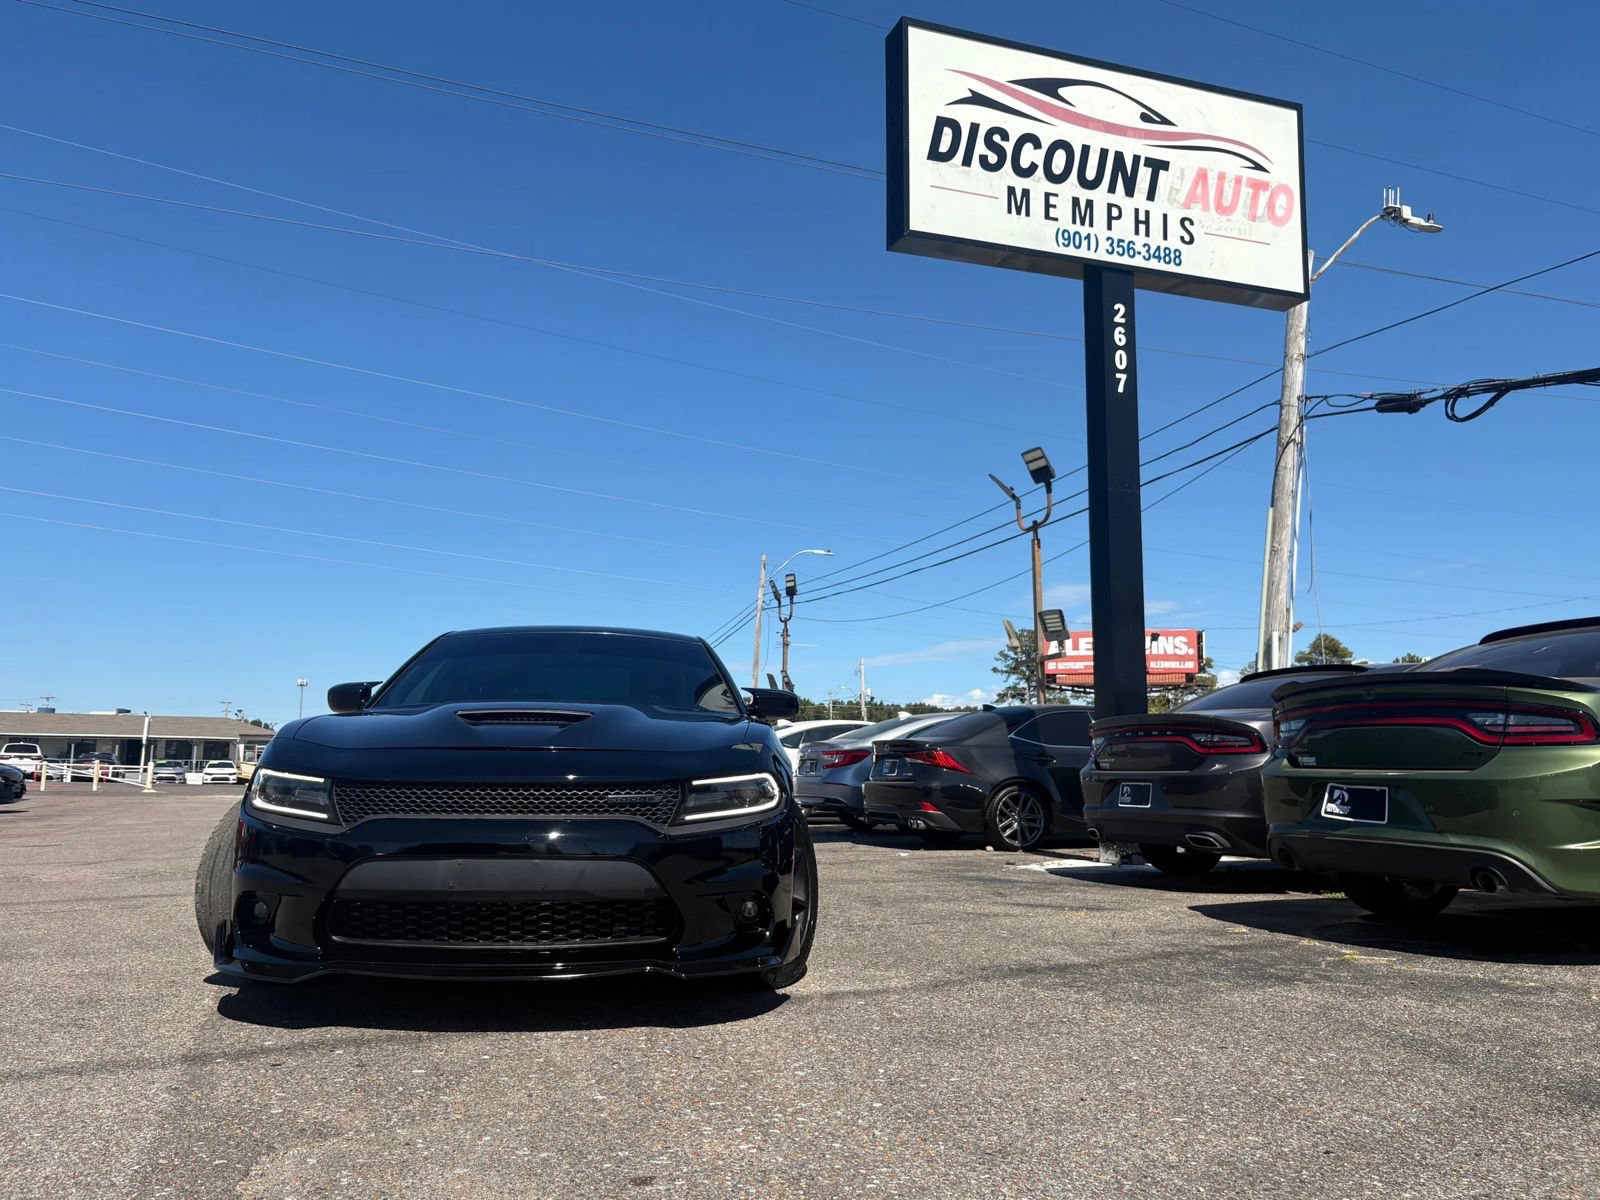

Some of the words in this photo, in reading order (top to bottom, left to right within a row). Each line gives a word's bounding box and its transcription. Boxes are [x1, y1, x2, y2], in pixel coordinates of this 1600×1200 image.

[926, 115, 1171, 202] DISCOUNT
[1183, 166, 1295, 227] AUTO
[1007, 186, 1195, 246] MEMPHIS
[1055, 227, 1099, 254] (901)
[1105, 236, 1183, 266] 356-3488
[1113, 303, 1128, 393] 2607
[1048, 636, 1094, 657] ALE
